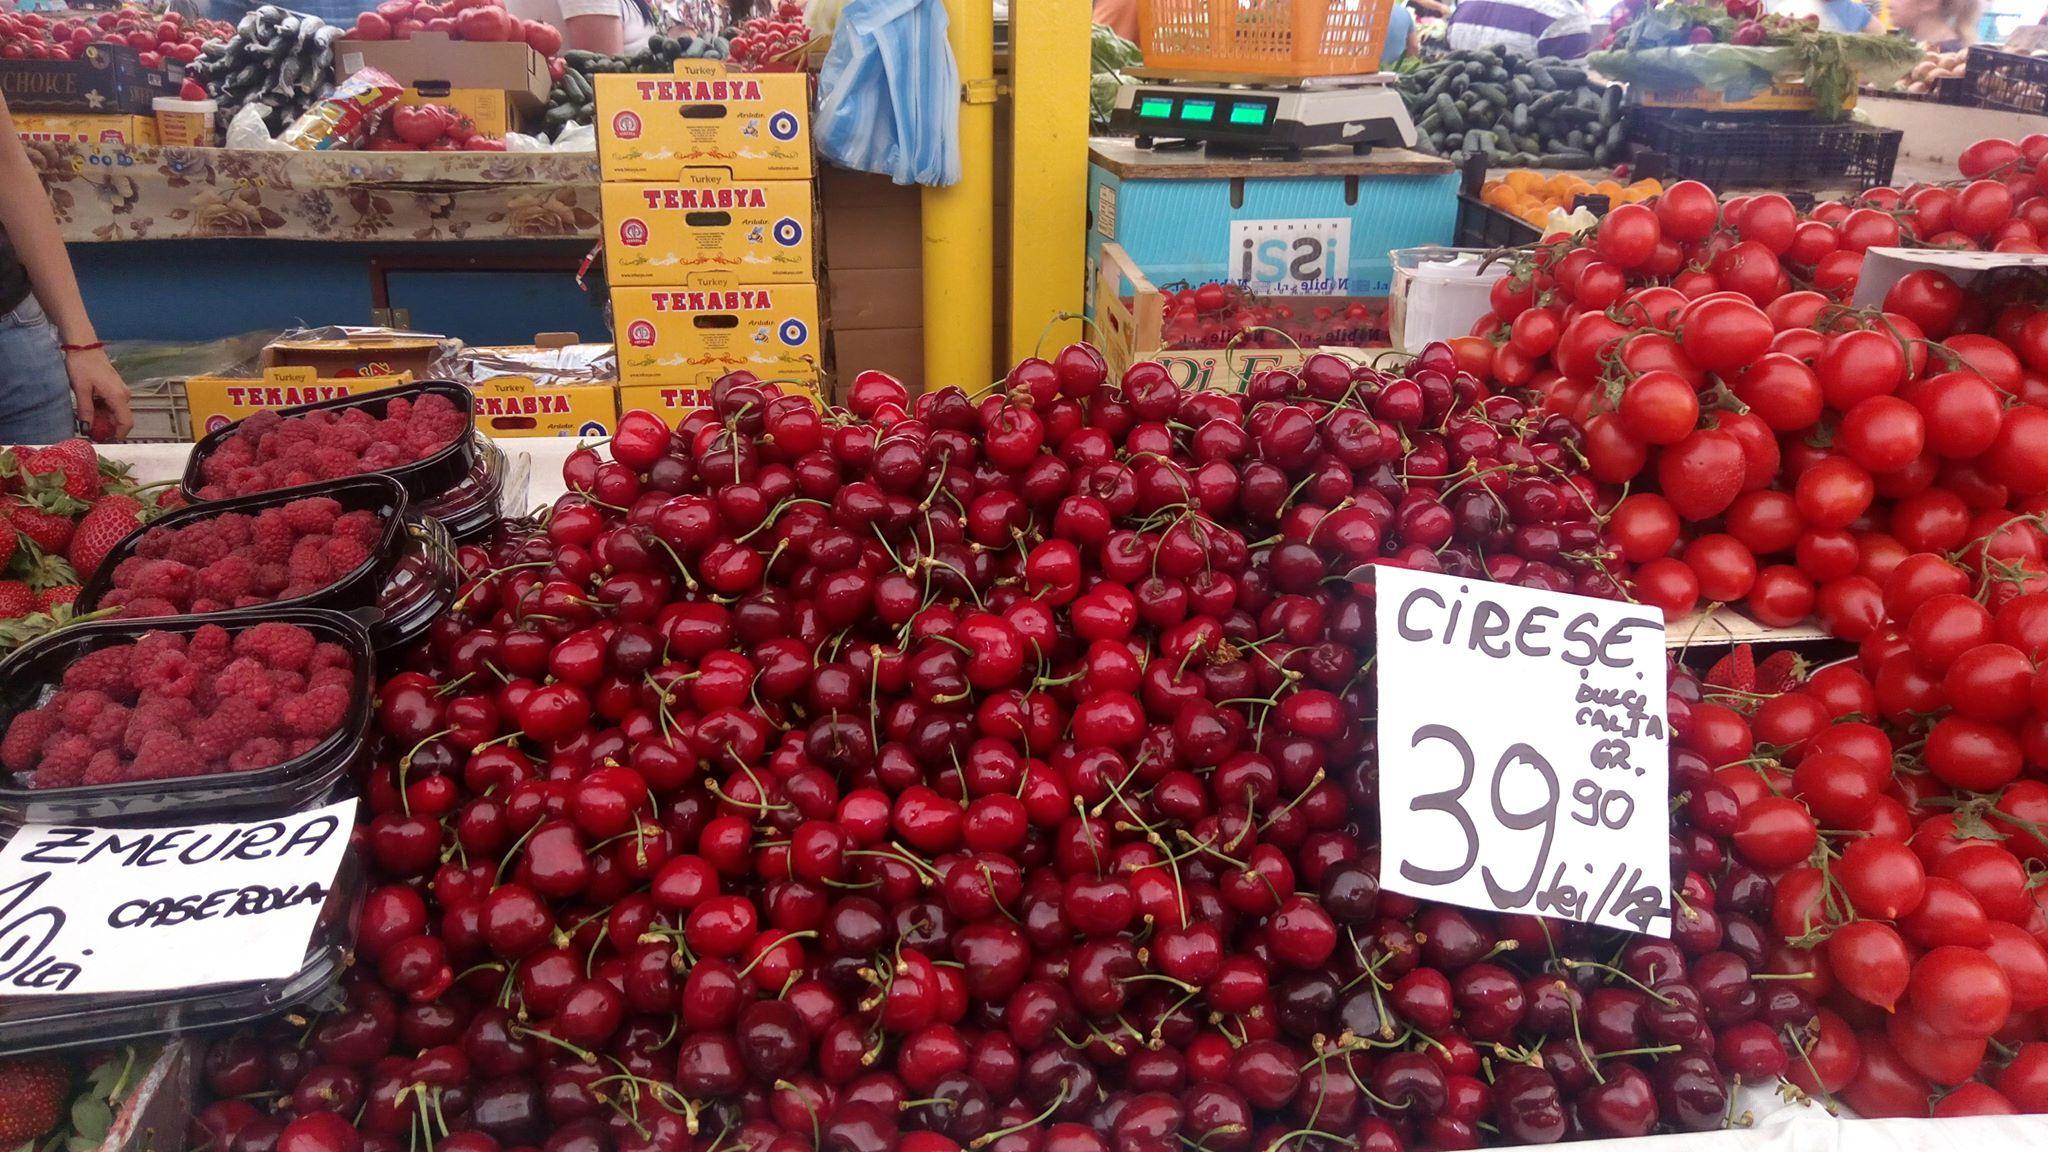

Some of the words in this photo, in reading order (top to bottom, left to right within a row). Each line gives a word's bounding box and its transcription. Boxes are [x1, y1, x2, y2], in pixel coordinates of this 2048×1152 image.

[684, 66, 716, 76] Turkey
[3, 71, 77, 94] CHOICE
[636, 81, 761, 100] TEKASYA
[690, 175, 722, 185] Turkey
[643, 188, 766, 208] TEKASYA
[1243, 223, 1338, 231] PREMIUM
[697, 278, 728, 288] Turkey
[651, 291, 772, 311] TEKASYA
[274, 374, 306, 383] Turkey
[494, 384, 526, 393] Turkey
[475, 395, 570, 416] EKASYA
[1399, 724, 1560, 909] 39
[1571, 779, 1635, 830] 90
[21, 815, 340, 867] ZMEURA
[107, 882, 330, 929] CASEROLA
